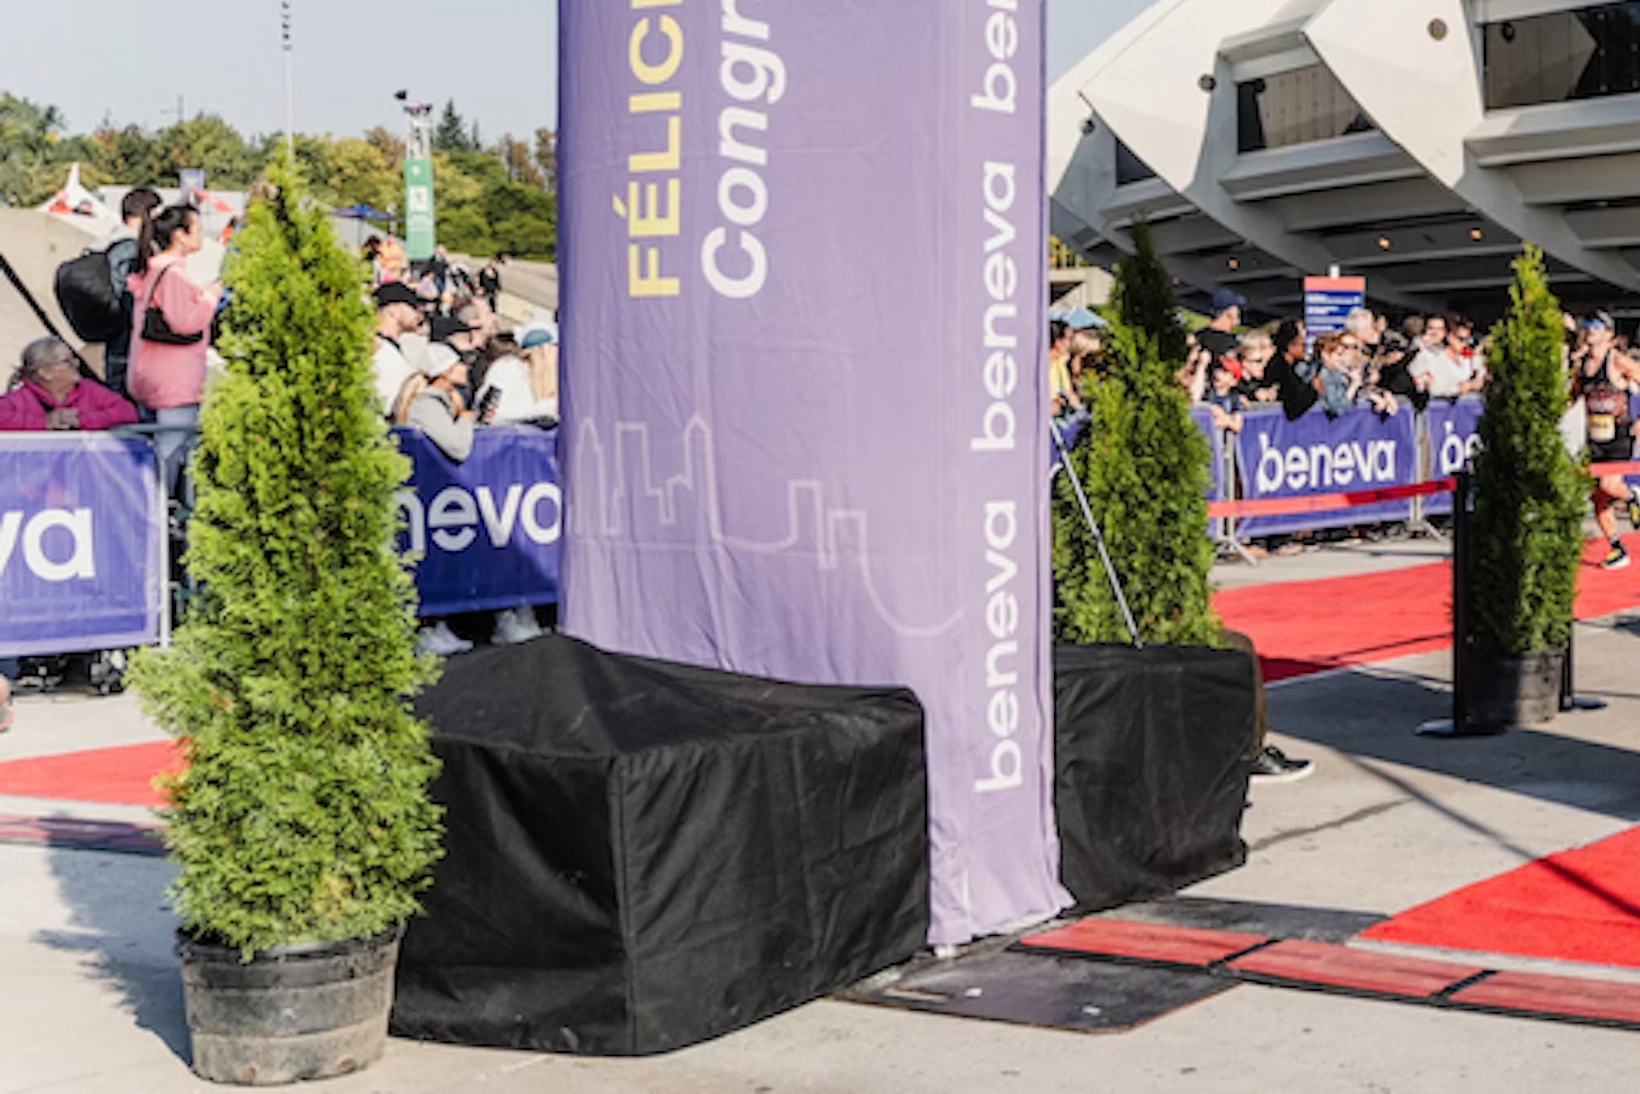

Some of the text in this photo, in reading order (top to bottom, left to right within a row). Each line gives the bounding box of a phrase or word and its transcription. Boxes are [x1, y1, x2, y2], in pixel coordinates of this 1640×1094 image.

[970, 161, 1019, 452] beneva
[1257, 432, 1396, 493] beneva
[974, 500, 1022, 793] beneva
